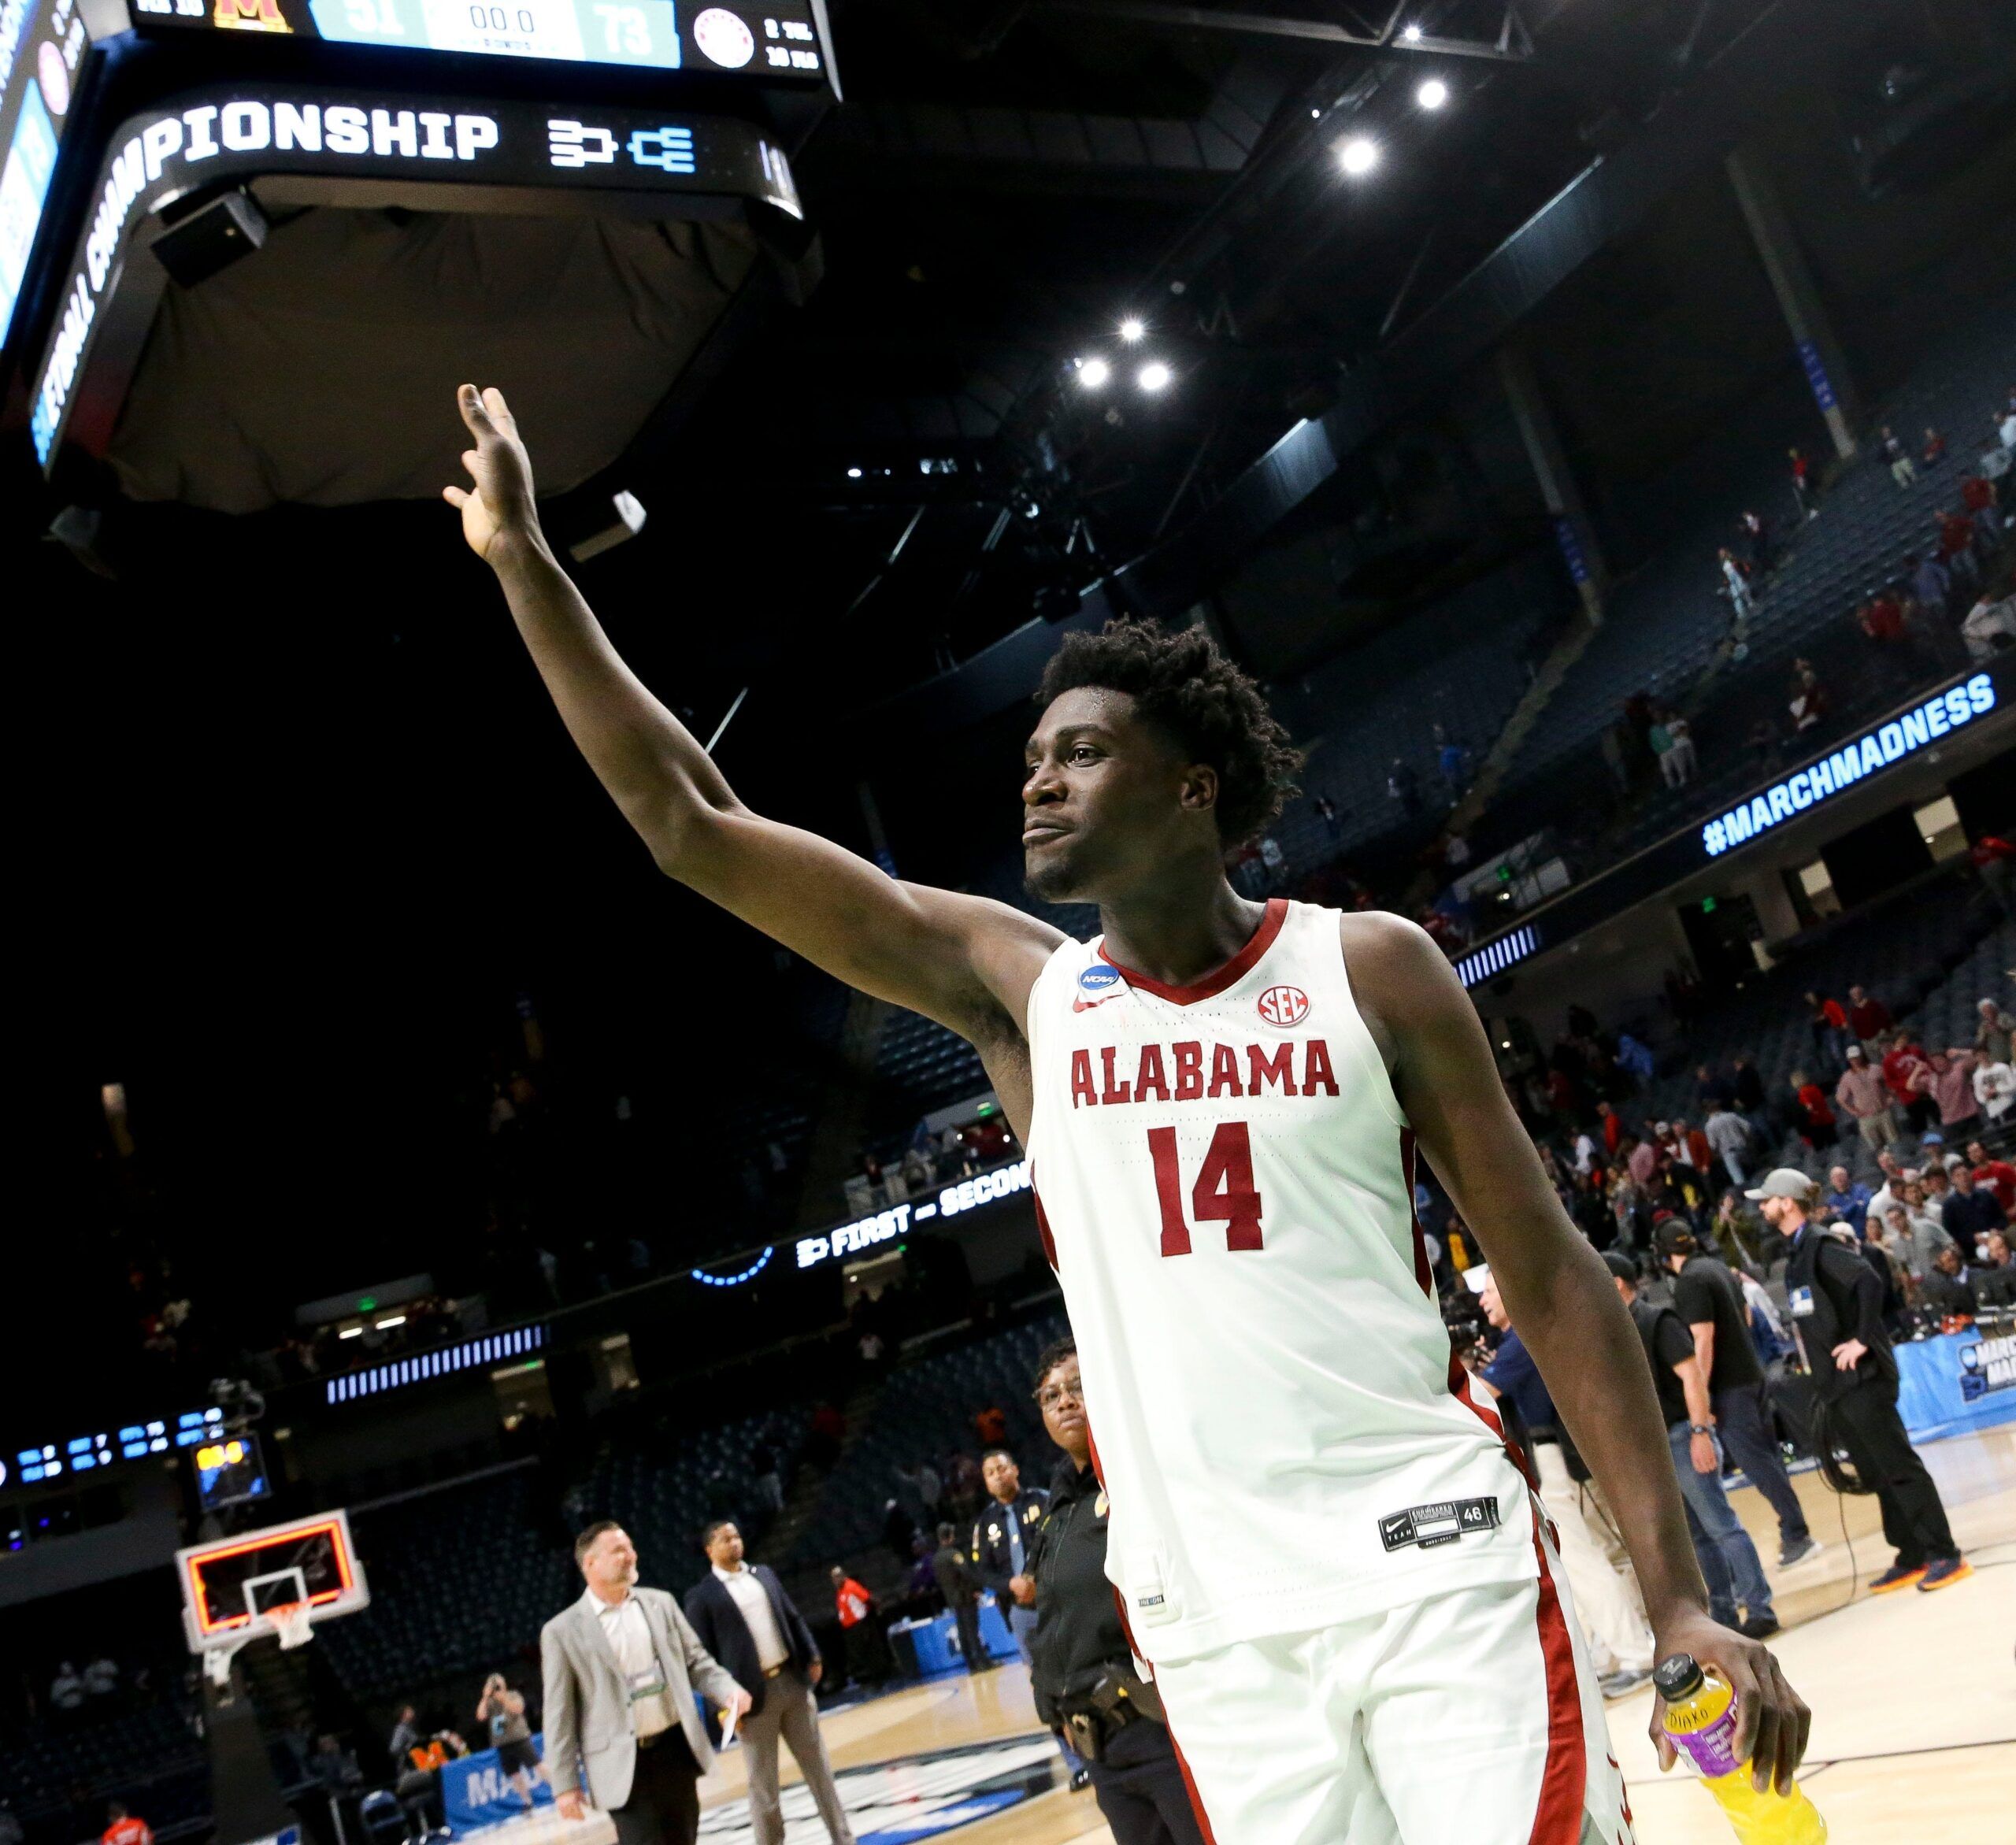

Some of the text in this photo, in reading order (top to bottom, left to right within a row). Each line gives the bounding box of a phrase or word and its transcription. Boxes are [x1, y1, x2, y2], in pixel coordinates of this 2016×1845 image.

[595, 5, 653, 56] 73
[86, 100, 500, 293] CHAMPIONSHIP
[1702, 673, 1996, 857] #MARCHMADNESS
[1081, 973, 1115, 984] NCAA
[1260, 987, 1310, 1024] SEC
[1071, 1039, 1340, 1110] ALABAMA
[1147, 1121, 1264, 1258] 14
[831, 1204, 911, 1258] FIRST
[1388, 1530, 1412, 1543] TEAM
[1463, 1506, 1482, 1522] 46
